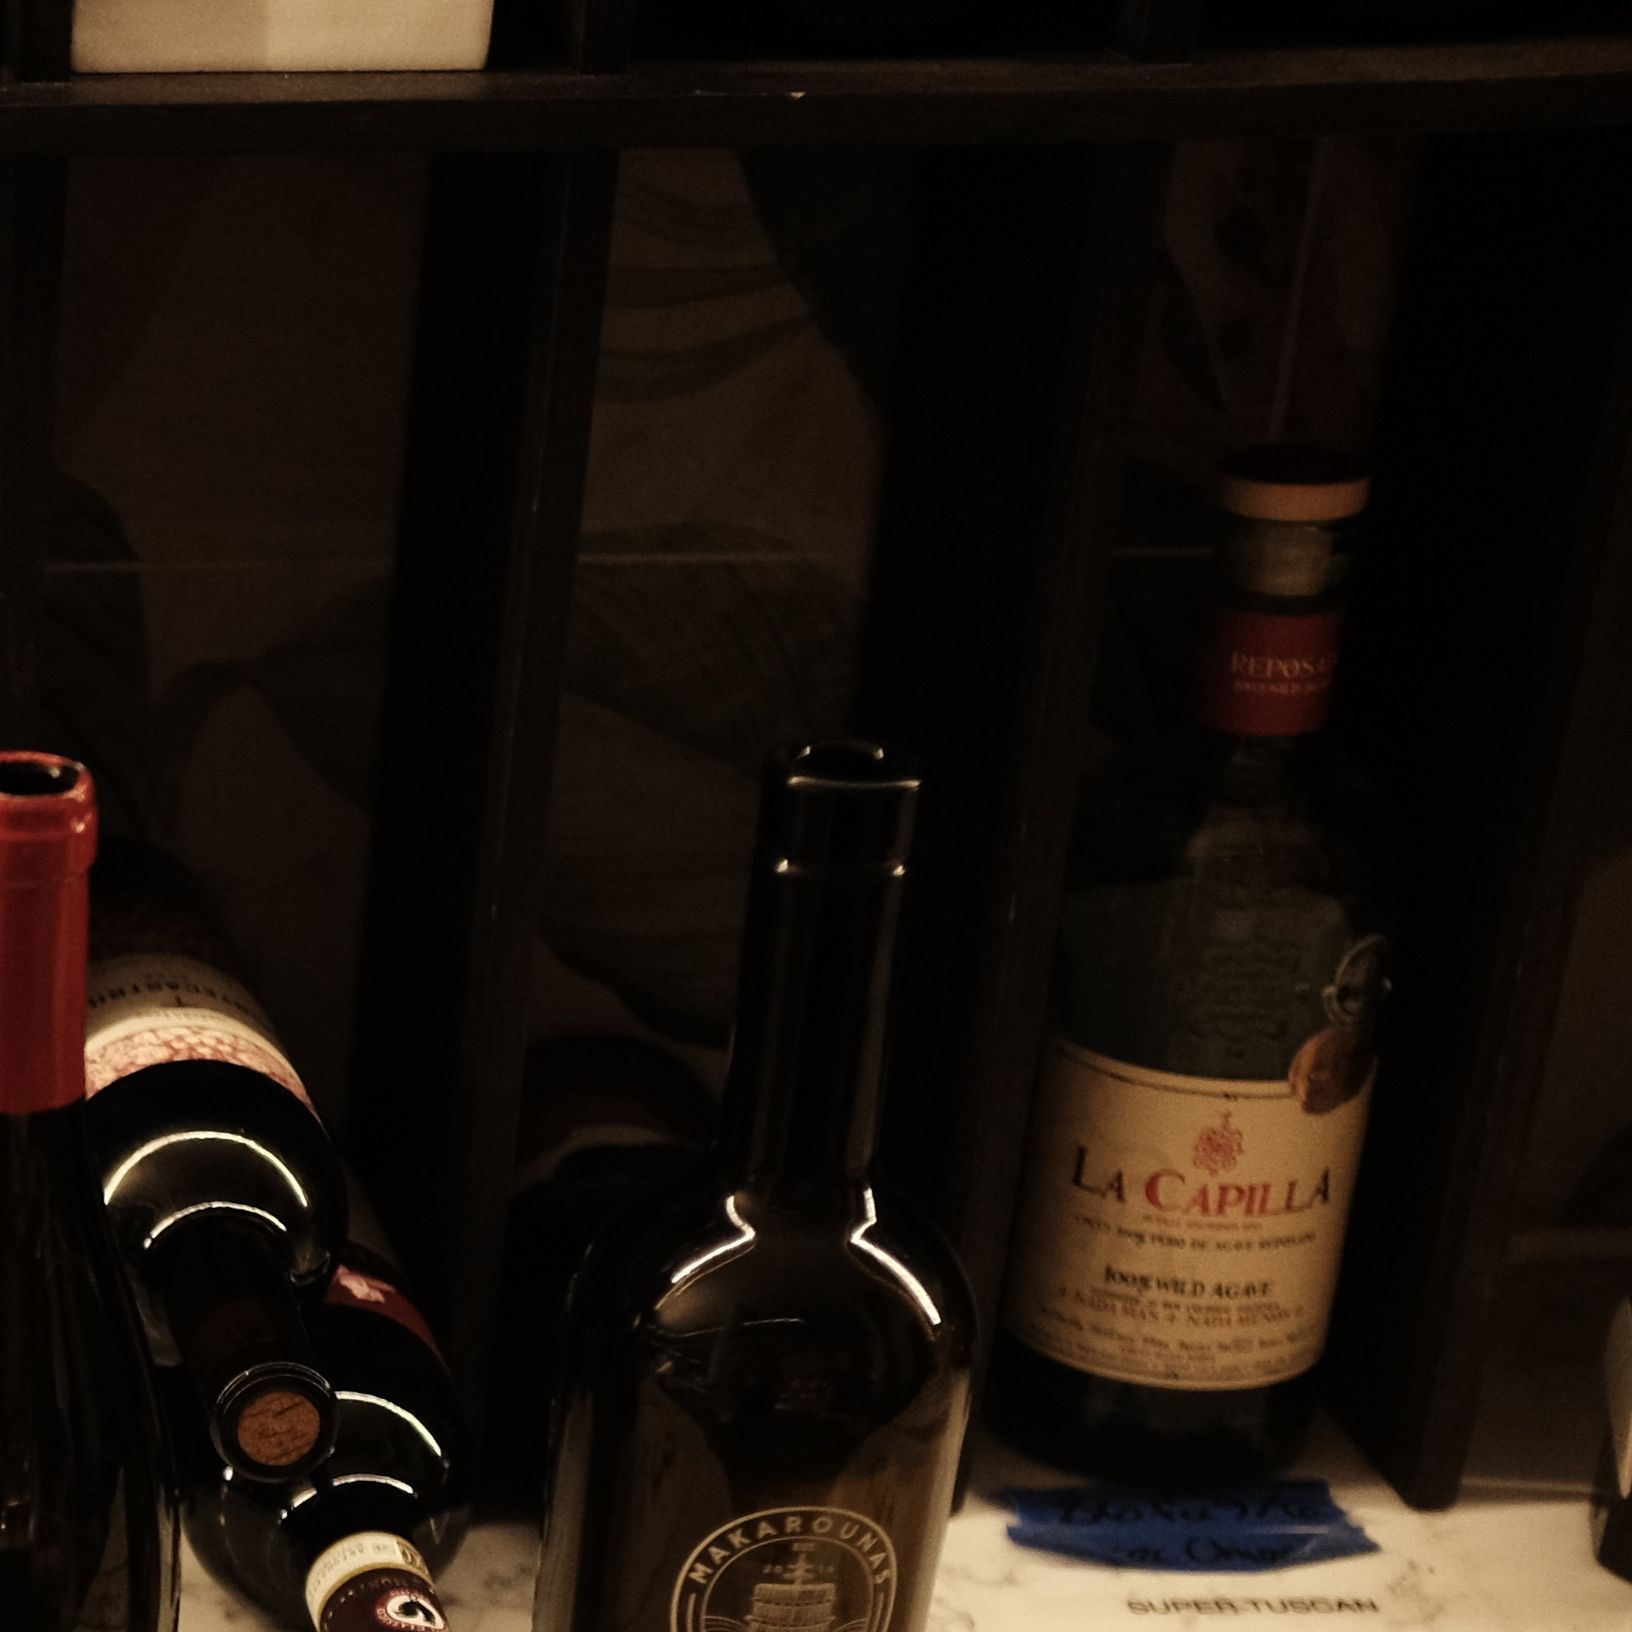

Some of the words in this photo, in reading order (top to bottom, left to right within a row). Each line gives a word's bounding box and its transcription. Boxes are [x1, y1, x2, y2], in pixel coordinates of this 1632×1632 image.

[1072, 1144, 1127, 1203] LA
[1144, 1168, 1332, 1217] CAPILLA
[1155, 1273, 1205, 1297] WILD
[1213, 1279, 1272, 1299] AGAVE
[687, 1514, 892, 1586] MAKAROUNAS
[1126, 1598, 1237, 1616] SUPER
[1244, 1598, 1379, 1615] TUSCAN
